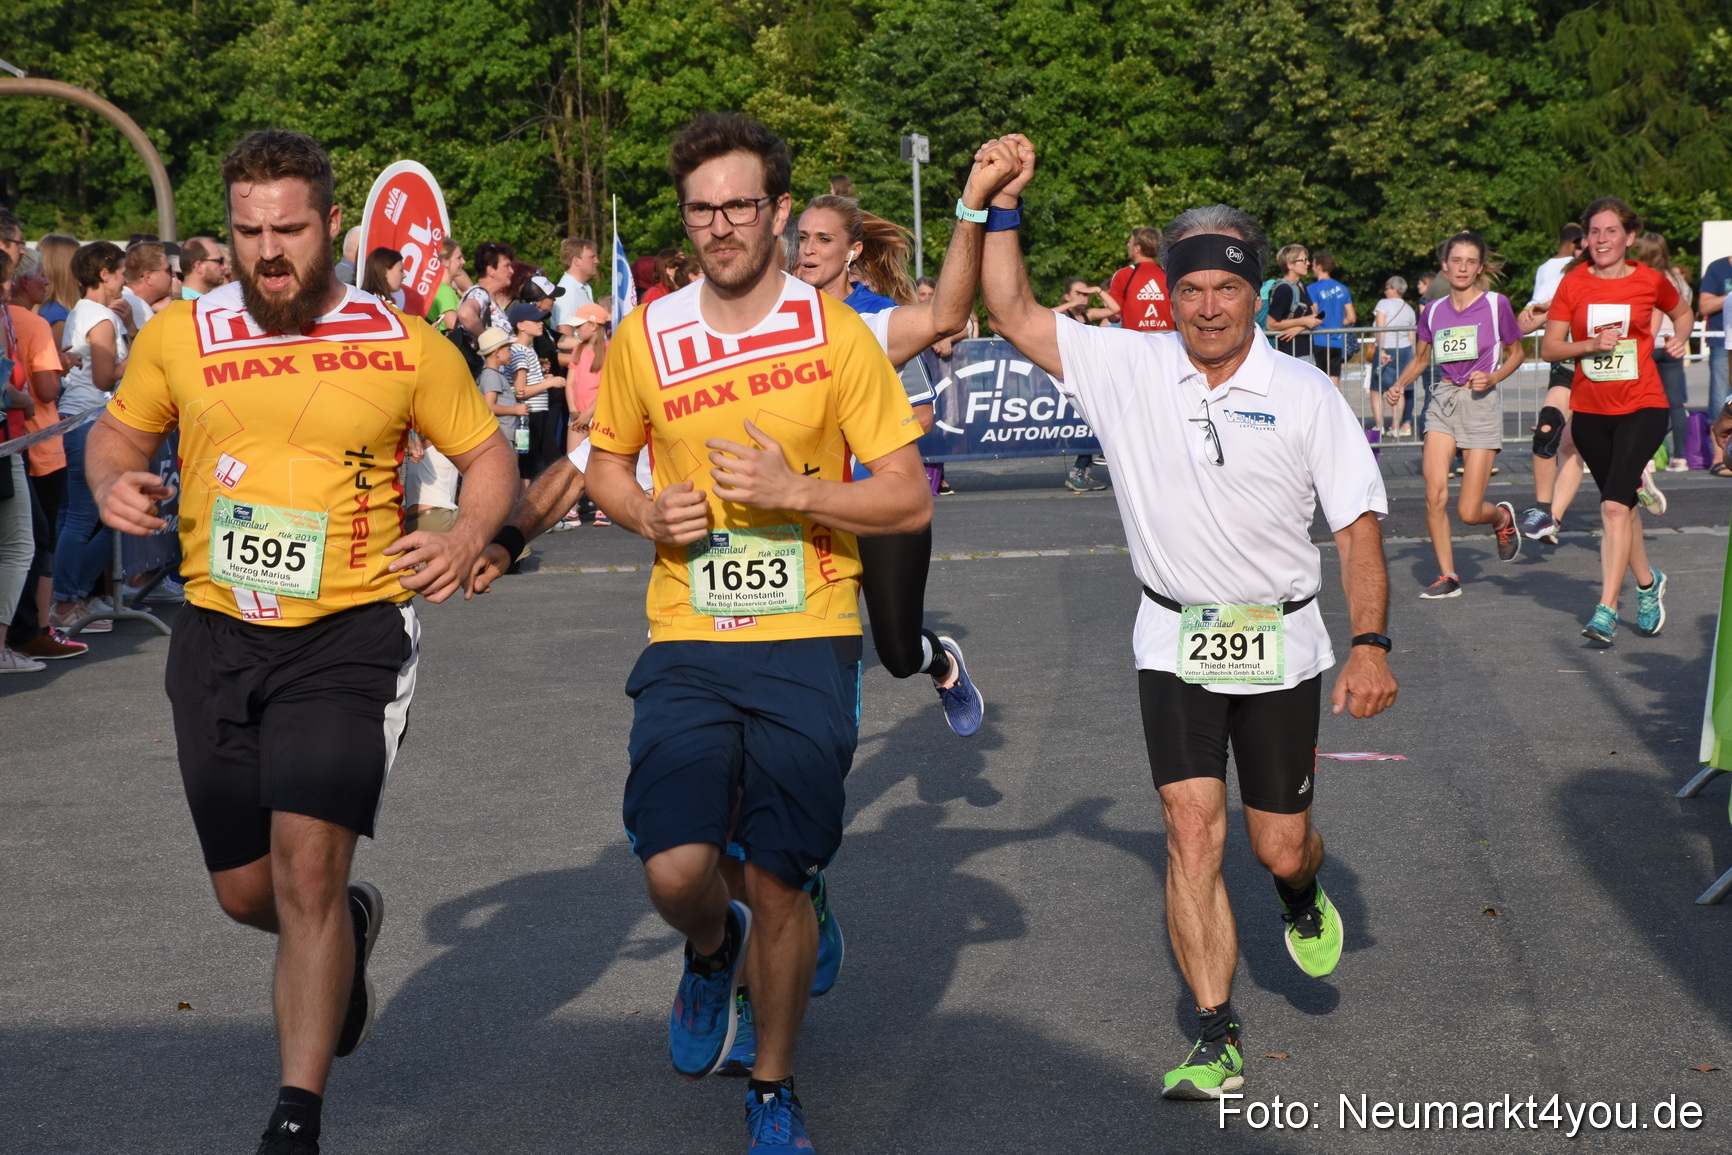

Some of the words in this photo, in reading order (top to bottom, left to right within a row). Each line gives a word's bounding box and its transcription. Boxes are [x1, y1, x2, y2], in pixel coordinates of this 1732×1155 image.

[1137, 292, 1165, 301] adidas
[1139, 320, 1167, 328] AREVA
[1443, 338, 1467, 352] 625
[203, 355, 300, 388] MAX
[312, 345, 416, 372] BÖGL
[1593, 355, 1624, 371] 527
[663, 380, 740, 422] MAX
[747, 359, 832, 397] BÖGL
[225, 515, 269, 531] firmenlauf
[295, 534, 317, 542] 2019
[222, 530, 307, 572] 1595
[774, 549, 796, 557] 2019
[229, 563, 258, 577] Herzog
[261, 569, 291, 580] Marius
[233, 572, 245, 580] Bögl
[246, 575, 279, 585] Bauservice
[702, 558, 789, 591] 1653
[708, 592, 733, 600] Preinl
[735, 591, 784, 600] Konstantin
[1189, 633, 1265, 661] 2391
